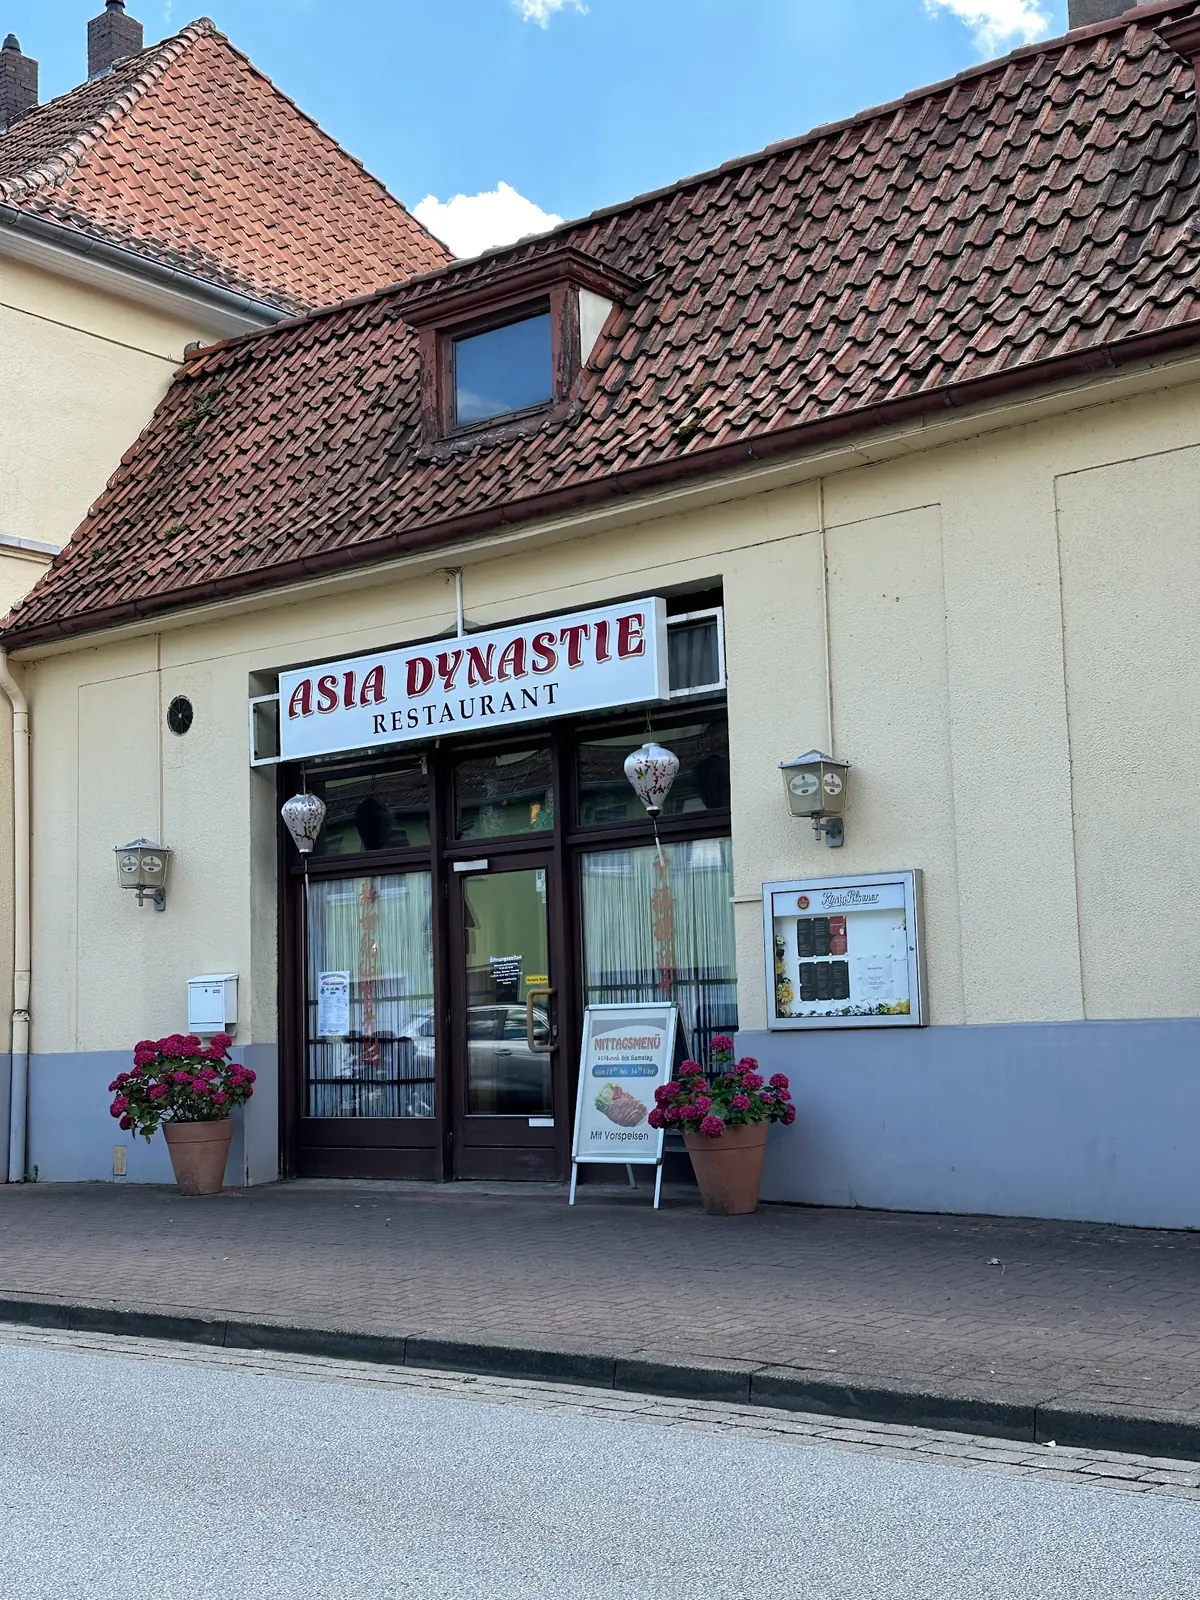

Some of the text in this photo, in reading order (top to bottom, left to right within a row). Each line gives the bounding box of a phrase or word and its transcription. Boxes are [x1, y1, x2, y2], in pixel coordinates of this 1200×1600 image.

[288, 613, 646, 721] ASIA DYNASTIE
[373, 682, 559, 734] RESTAURANT
[594, 1034, 661, 1051] MITTAGSMENÜ
[590, 1131, 649, 1142] Mit Vorspeisen
